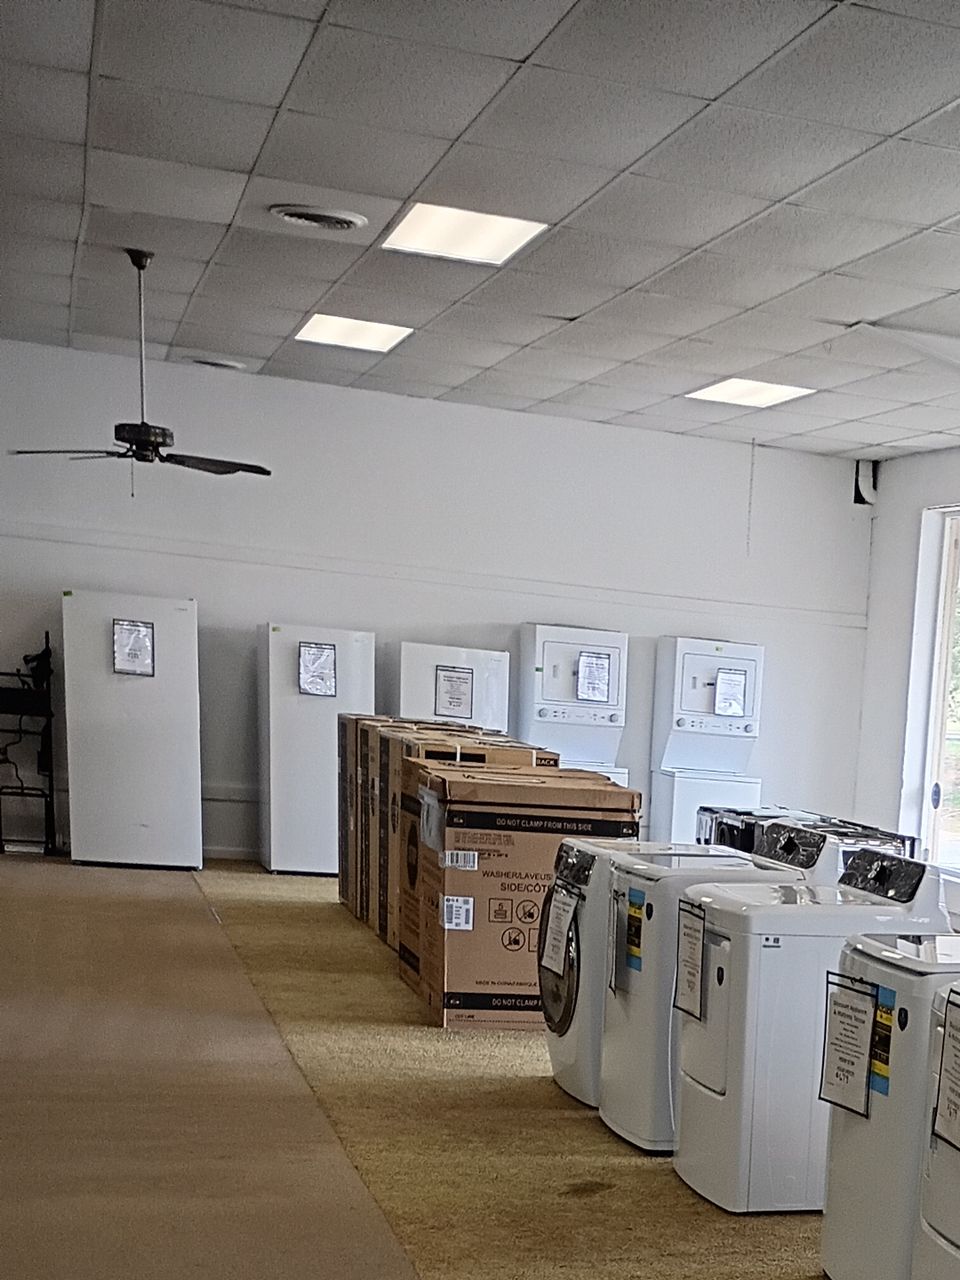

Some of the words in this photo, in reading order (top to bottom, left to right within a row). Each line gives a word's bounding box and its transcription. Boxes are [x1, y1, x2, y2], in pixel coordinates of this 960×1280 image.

[497, 818, 506, 826] DO
[507, 819, 520, 827] NOT
[521, 820, 543, 828] CLAMP
[544, 821, 562, 829] FROM
[563, 822, 577, 830] THIS
[482, 869, 553, 881] WASHER/LAVEUS
[492, 998, 501, 1006] DO
